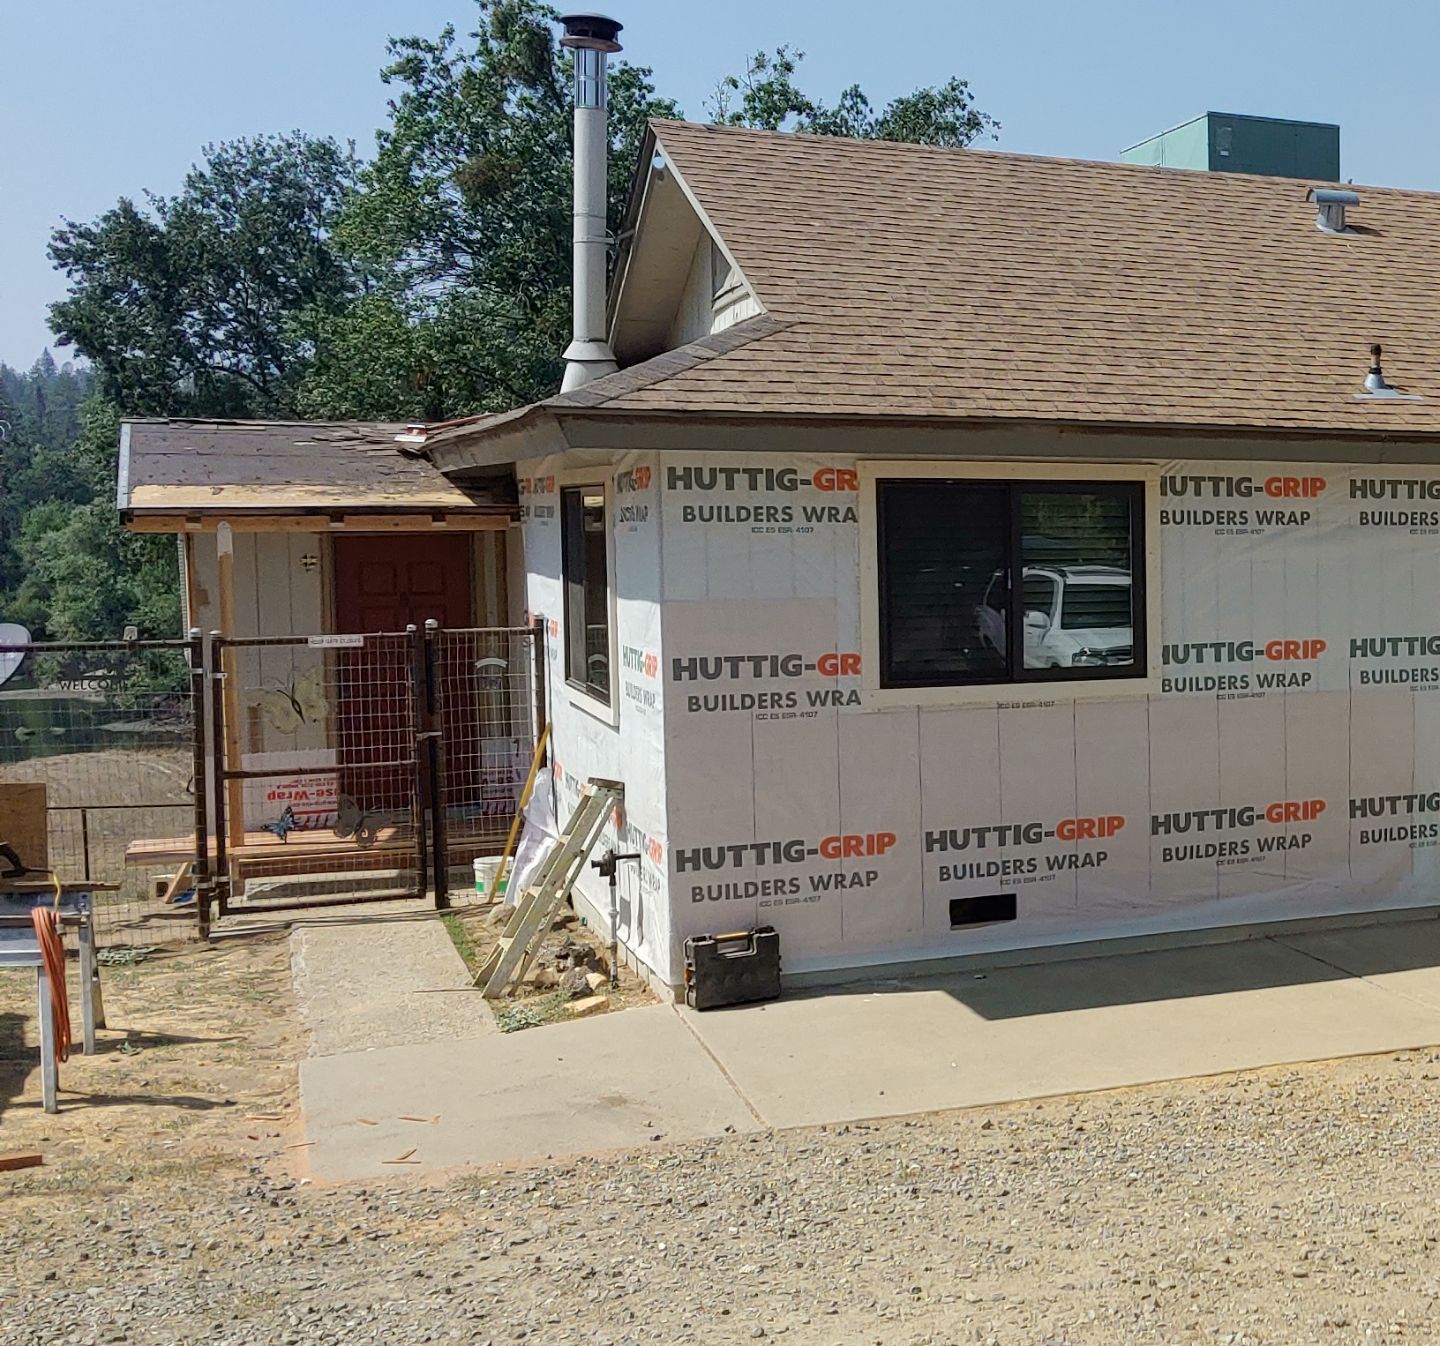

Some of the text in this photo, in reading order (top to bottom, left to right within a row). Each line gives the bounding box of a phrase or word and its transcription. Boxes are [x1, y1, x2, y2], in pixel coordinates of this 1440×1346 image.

[667, 467, 859, 492] HUTTIG-GR
[682, 505, 858, 523] BUILDERS WRA
[1160, 510, 1311, 526] BUILDERS WRAP
[1359, 511, 1439, 526] BUILDERS
[672, 653, 862, 681] HUTTIG-GR
[1360, 668, 1439, 684] BUILDERS
[1162, 672, 1312, 693] BUILDERS WRAP
[687, 690, 862, 712] BUILDERS WRA
[1151, 799, 1326, 835] HUTTIG-GRIP
[925, 815, 1125, 852] HUTTIG-GRIP
[1360, 824, 1438, 844] BUILDERS
[676, 832, 897, 872] HUTTIG-GRIP
[1162, 834, 1312, 862] BUILDERS WRAP
[939, 851, 1108, 881] BUILDERS WRAP
[691, 870, 878, 903] BUILDERS WRAP
